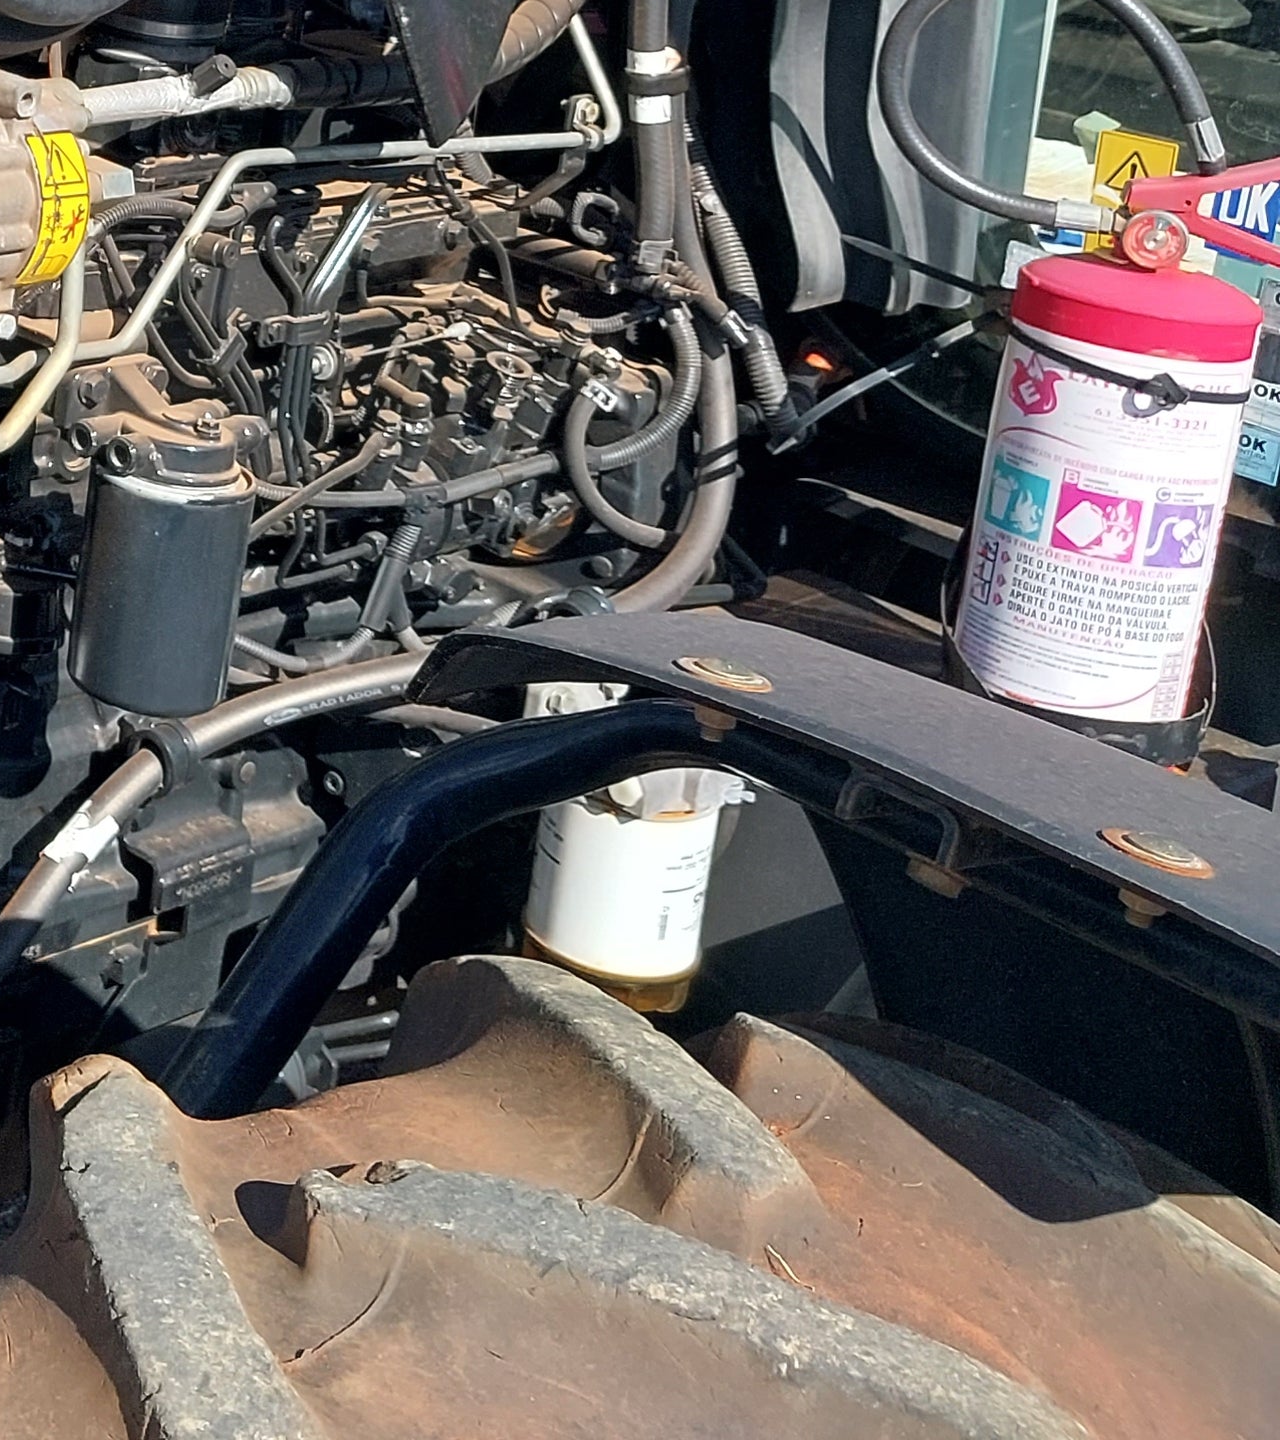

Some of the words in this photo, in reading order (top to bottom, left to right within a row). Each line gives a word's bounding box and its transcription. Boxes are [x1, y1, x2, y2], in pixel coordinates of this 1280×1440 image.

[1240, 435, 1266, 454] OK
[1016, 552, 1034, 566] USE
[1037, 561, 1044, 570] O
[1047, 562, 1099, 583] EXTINTOR
[1103, 577, 1117, 587] NA
[1021, 567, 1047, 583] PUXE
[1049, 577, 1056, 586] A
[1061, 579, 1095, 595] TRAVA
[1100, 587, 1157, 605] ROMPENDO
[1009, 589, 1045, 608] APERTE
[1048, 602, 1055, 611] O
[1058, 604, 1105, 624] GATILHO
[1108, 615, 1122, 626] DA
[1012, 577, 1048, 596] SEGURE
[1051, 588, 1084, 607] FIRME
[1087, 598, 1103, 610] NA
[1106, 603, 1165, 619] MANGUEIRA
[1007, 600, 1037, 620] DIRIJA
[1040, 612, 1046, 622] O
[1050, 615, 1077, 631] JATO
[1081, 624, 1095, 634] DE
[1125, 629, 1149, 642] BASE
[1152, 632, 1164, 642] DO
[307, 686, 383, 712] RADIADOR
